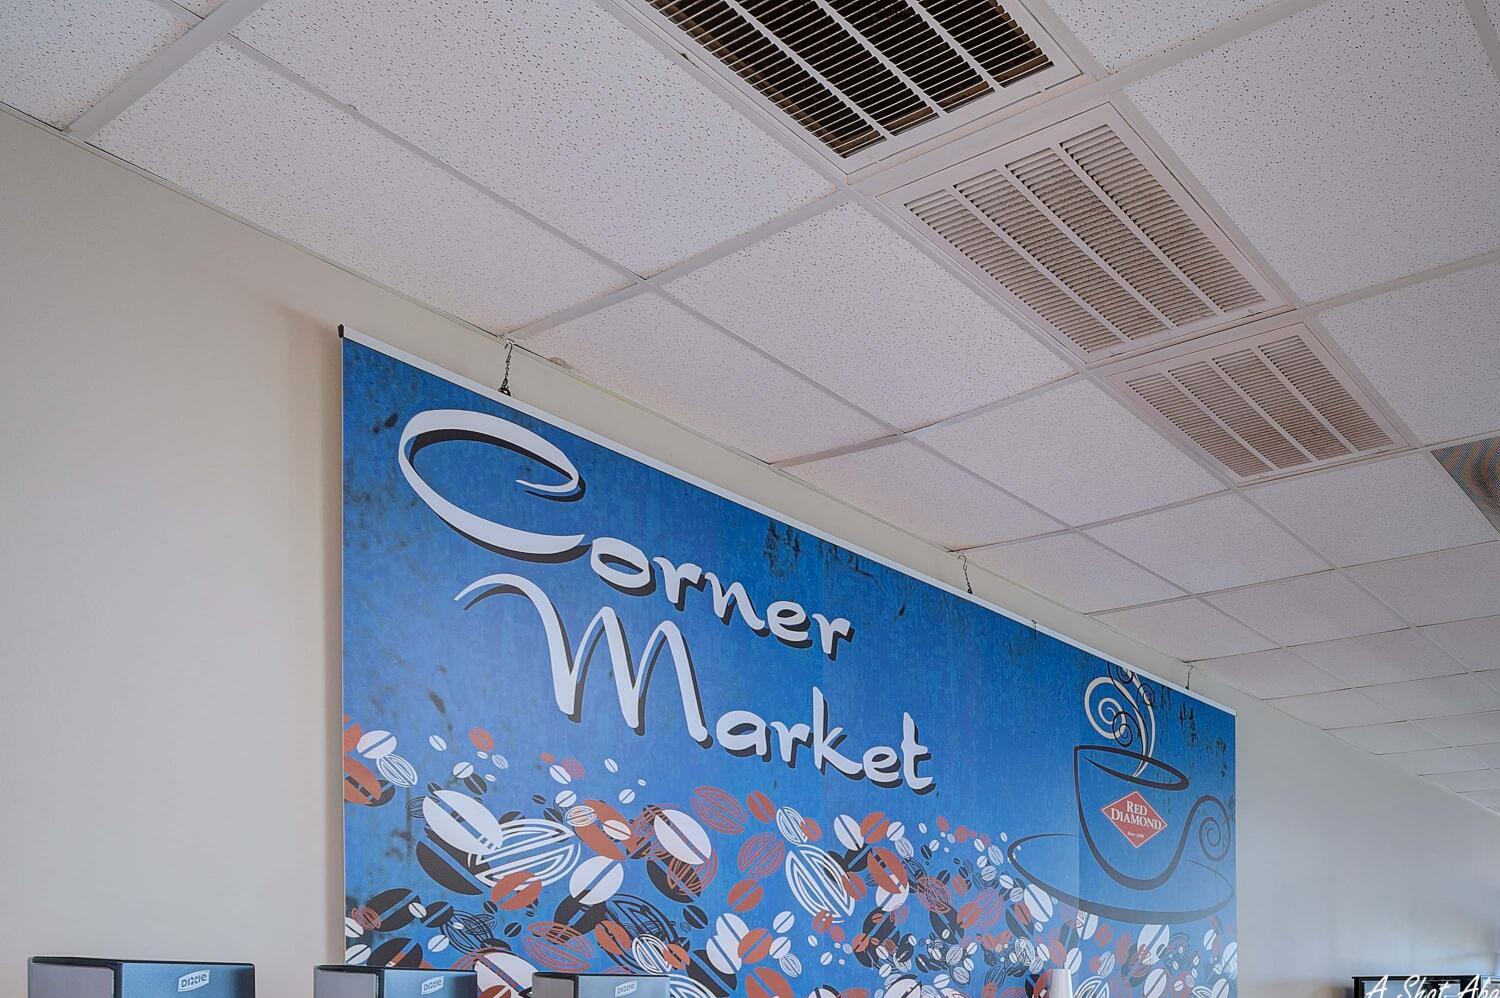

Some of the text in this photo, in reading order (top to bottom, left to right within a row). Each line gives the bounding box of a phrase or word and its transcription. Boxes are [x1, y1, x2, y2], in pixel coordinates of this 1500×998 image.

[398, 409, 854, 661] Corner
[454, 573, 936, 795] Market
[1111, 808, 1162, 830] DIAMOND
[1126, 800, 1148, 816] RED
[181, 972, 207, 989] DIXIE
